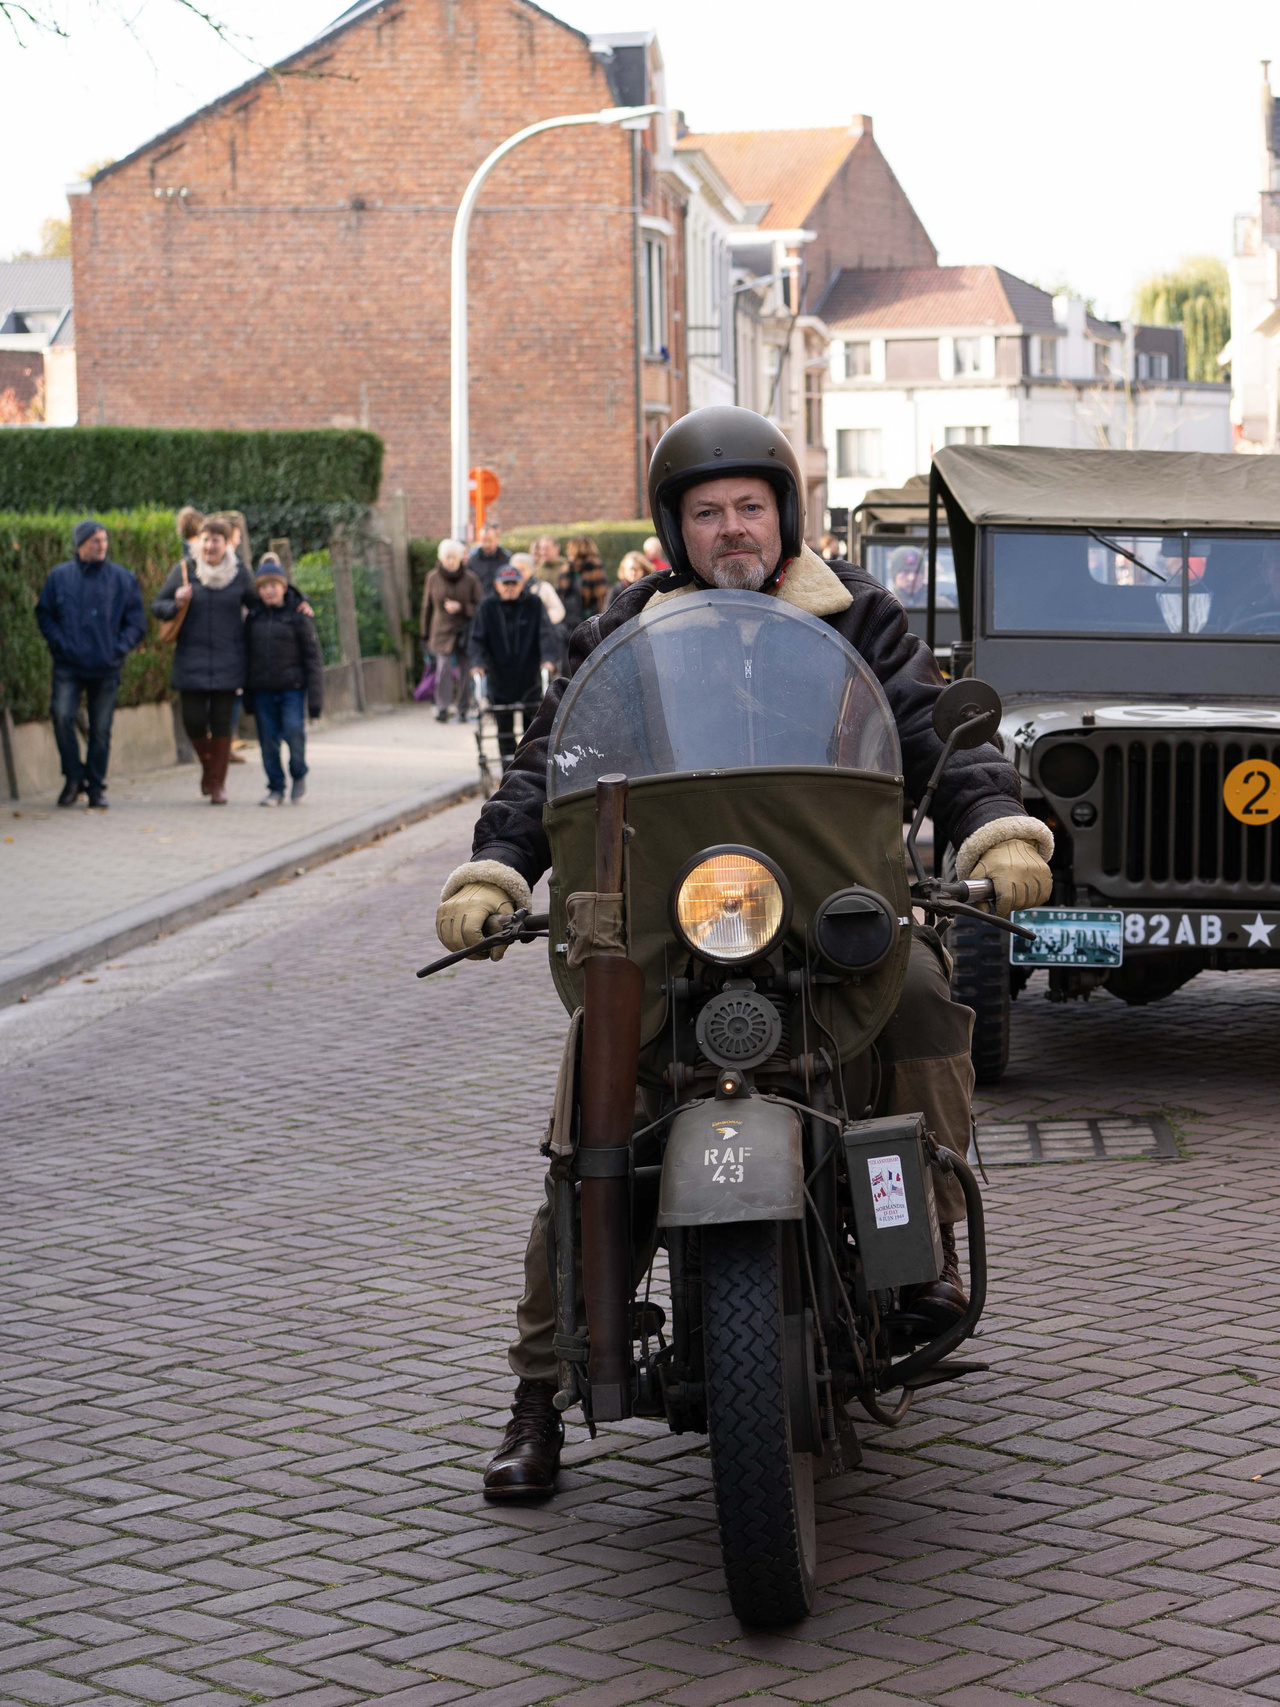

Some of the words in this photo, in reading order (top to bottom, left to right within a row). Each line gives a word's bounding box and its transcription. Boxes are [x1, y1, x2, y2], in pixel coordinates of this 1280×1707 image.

[1241, 770, 1271, 814] 2
[1048, 912, 1088, 920] 1944
[1124, 913, 1222, 945] 82AB
[1059, 928, 1110, 949] D-DAY
[1046, 954, 1087, 963] 2019
[704, 1147, 753, 1166] RAF
[712, 1165, 743, 1183] 43
[876, 1203, 905, 1212] NORMANDIE
